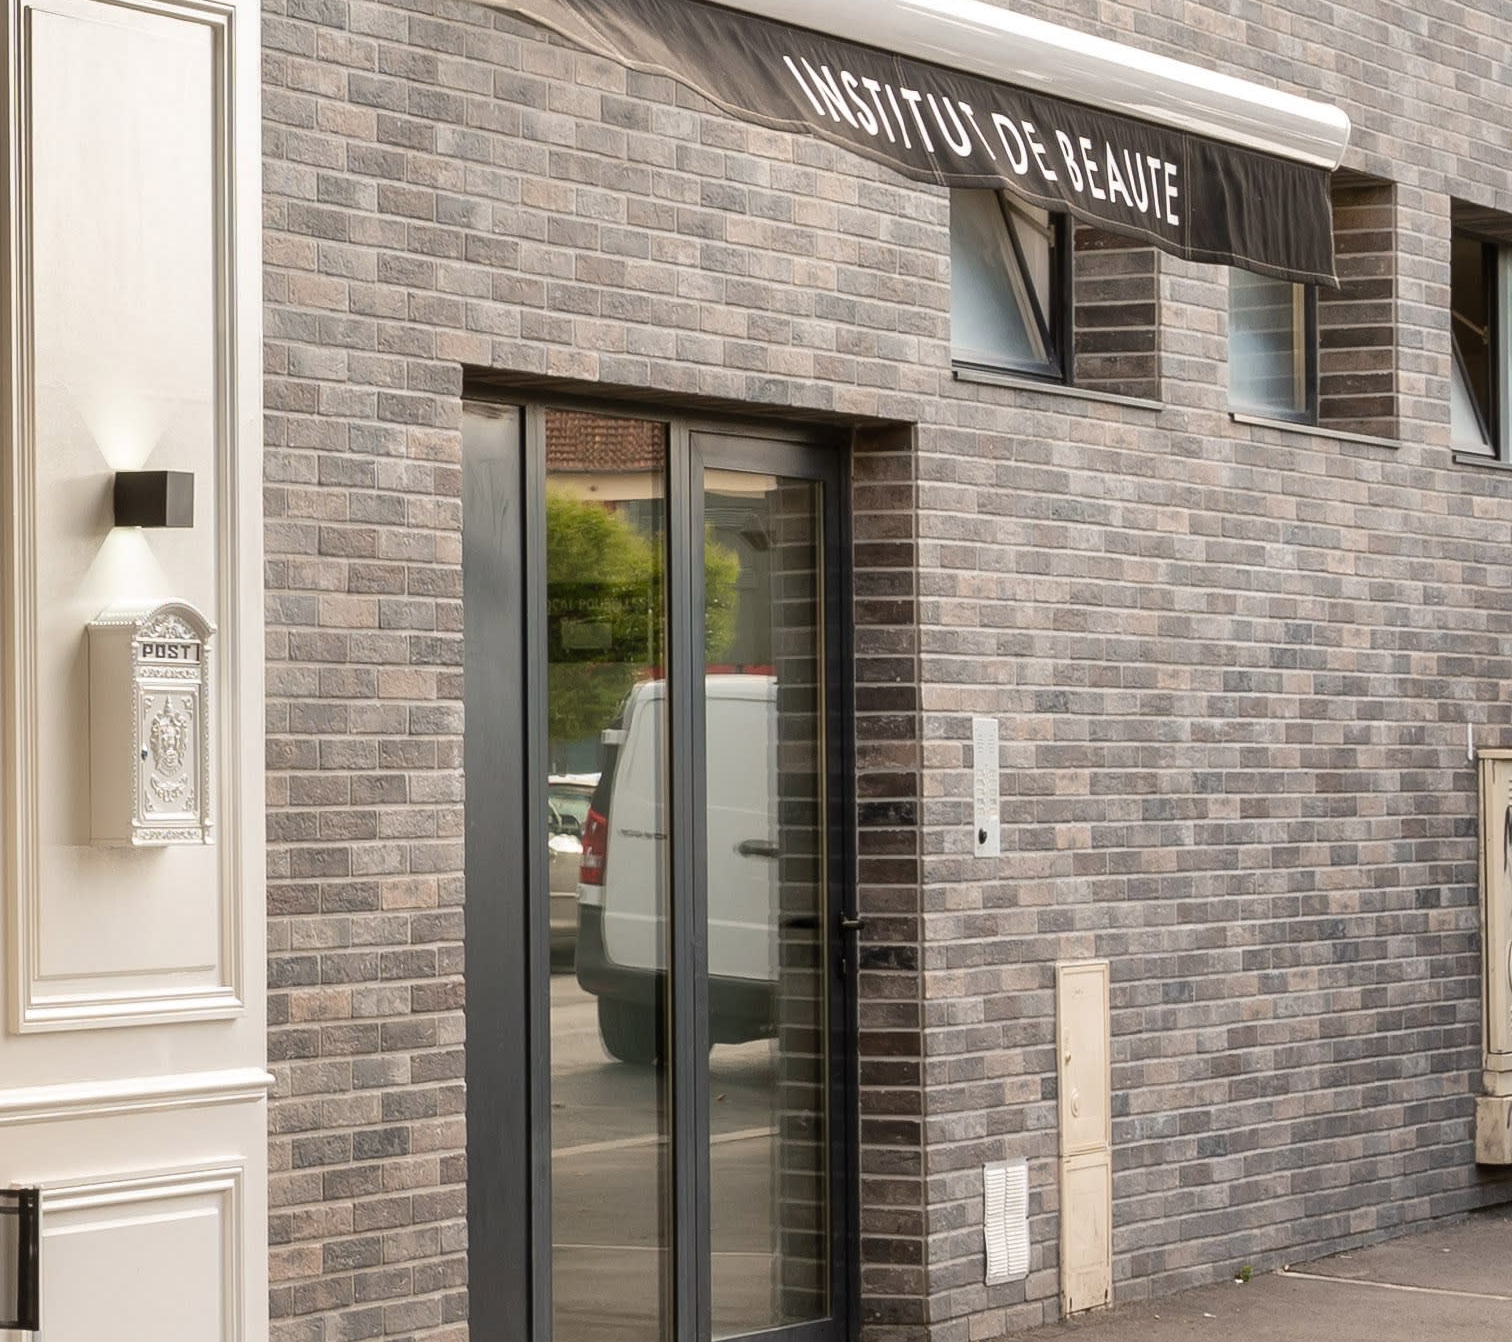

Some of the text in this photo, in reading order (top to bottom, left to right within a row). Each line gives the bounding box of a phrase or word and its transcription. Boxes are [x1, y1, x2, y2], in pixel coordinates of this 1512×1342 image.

[782, 54, 1181, 227] INSTITUT DE BEAUTE
[142, 643, 191, 659] POST
